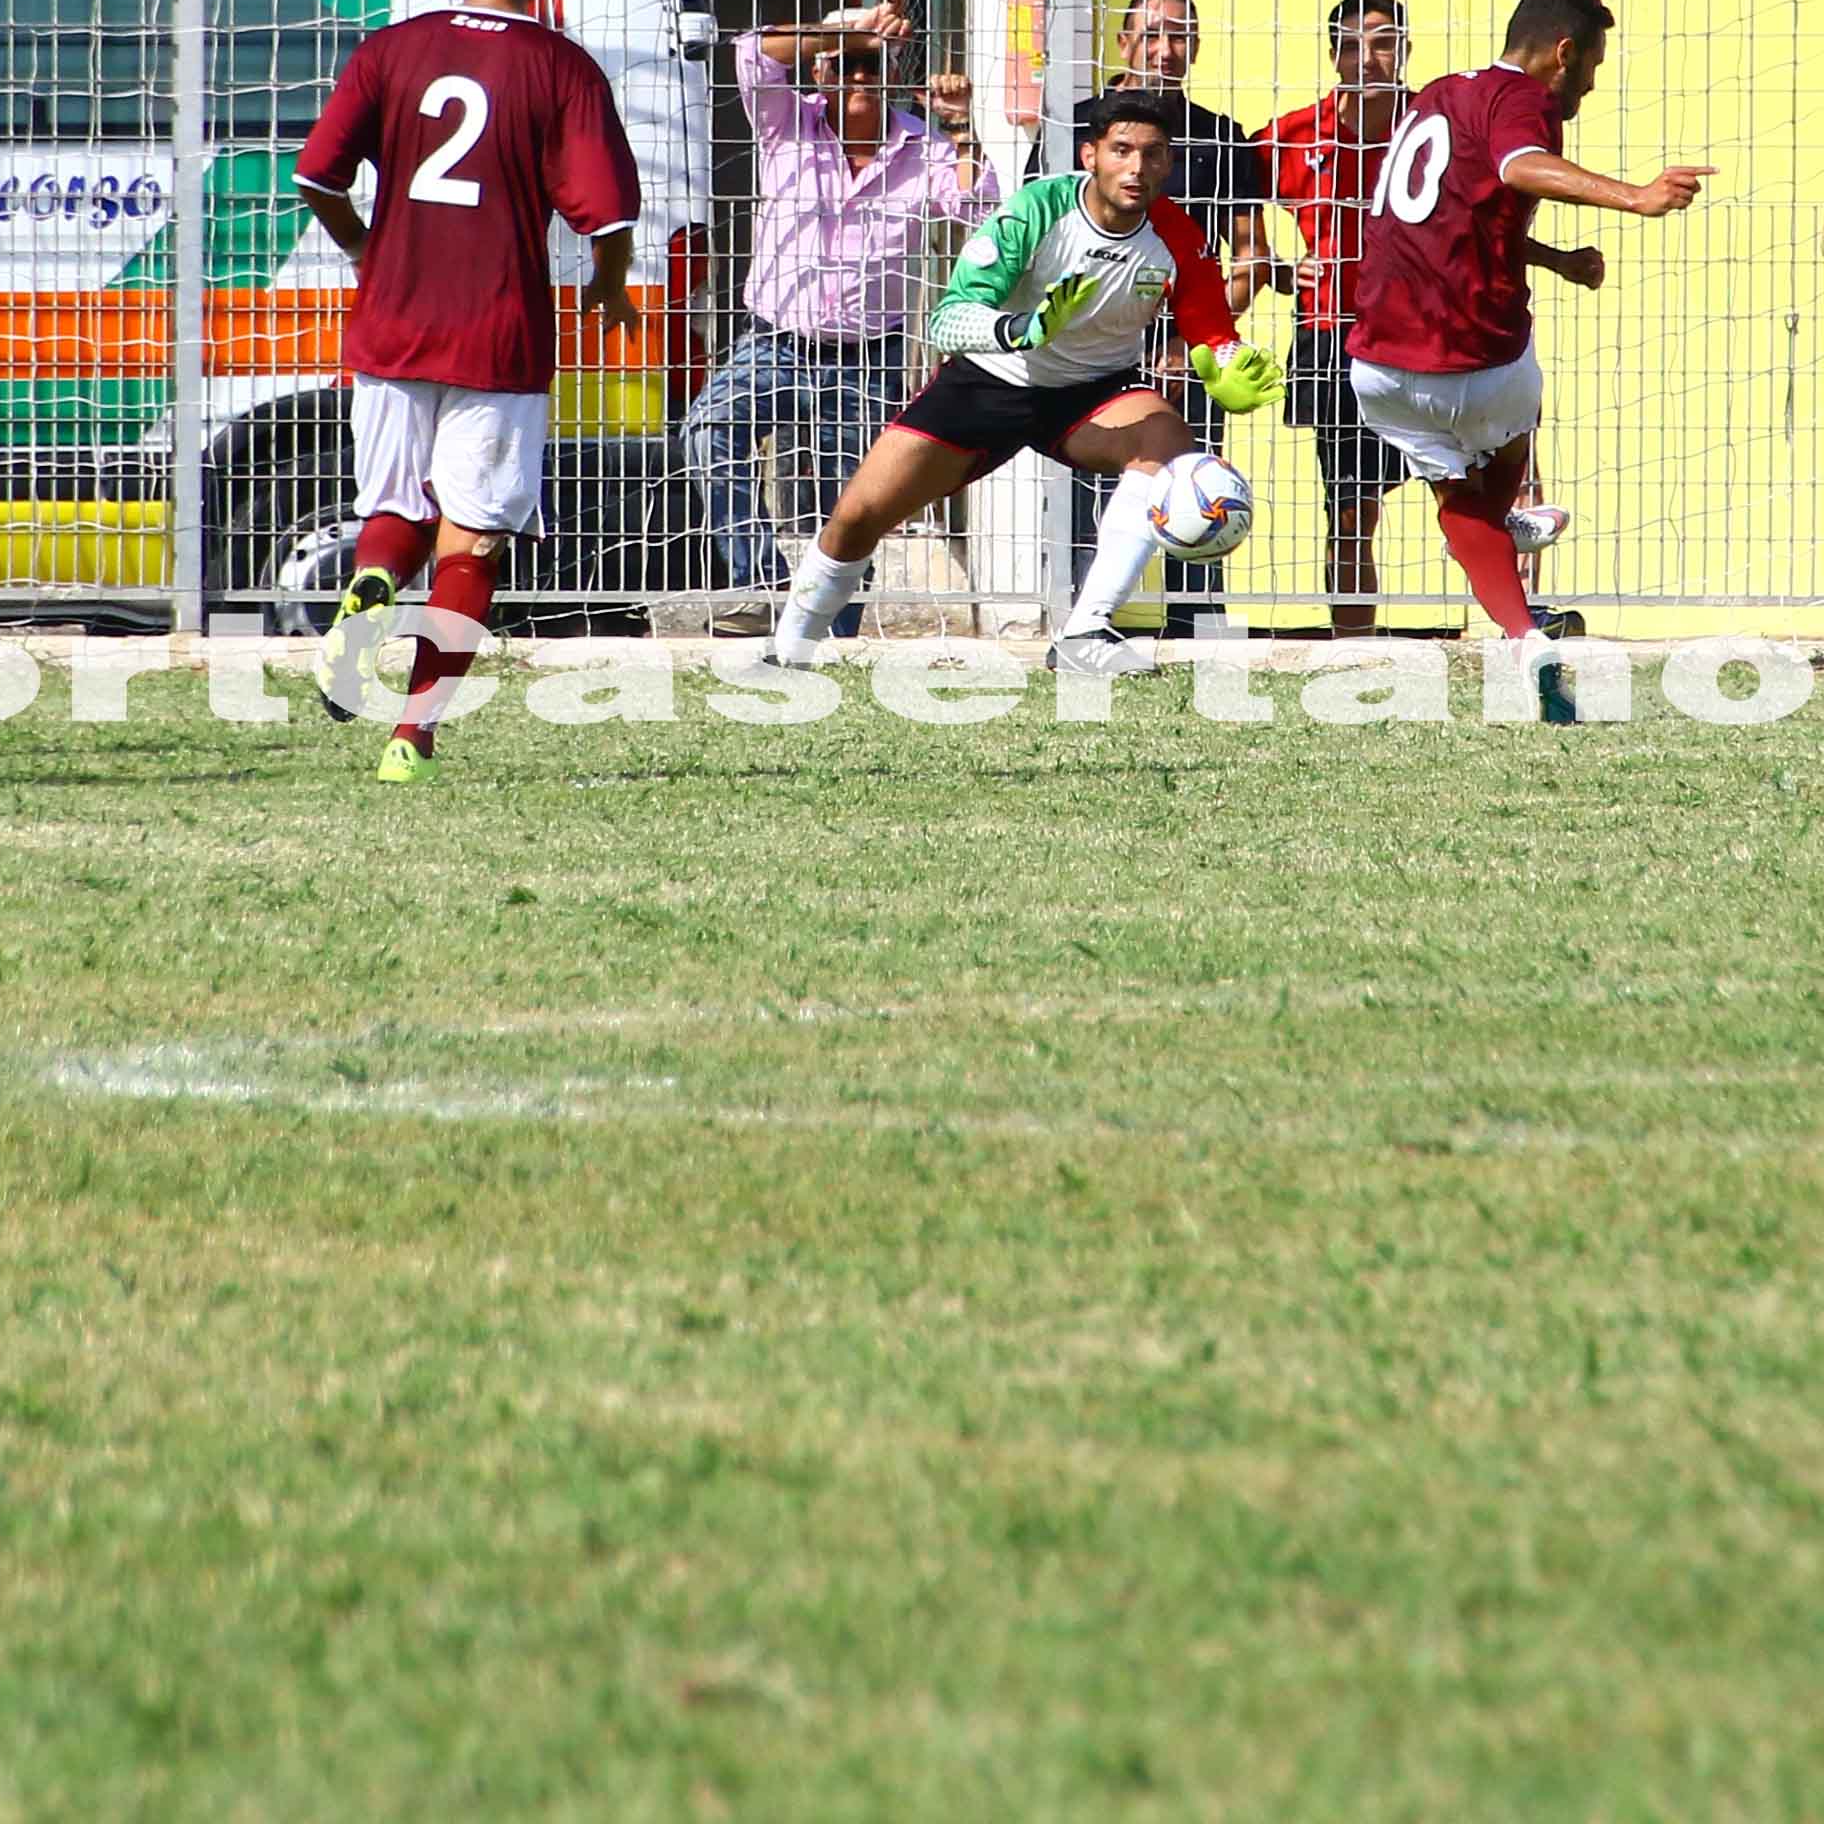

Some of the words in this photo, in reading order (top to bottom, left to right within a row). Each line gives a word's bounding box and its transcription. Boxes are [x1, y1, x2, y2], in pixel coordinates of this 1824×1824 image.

[408, 75, 489, 207] 2
[1370, 109, 1452, 225] 10
[1085, 248, 1128, 263] LEGEA
